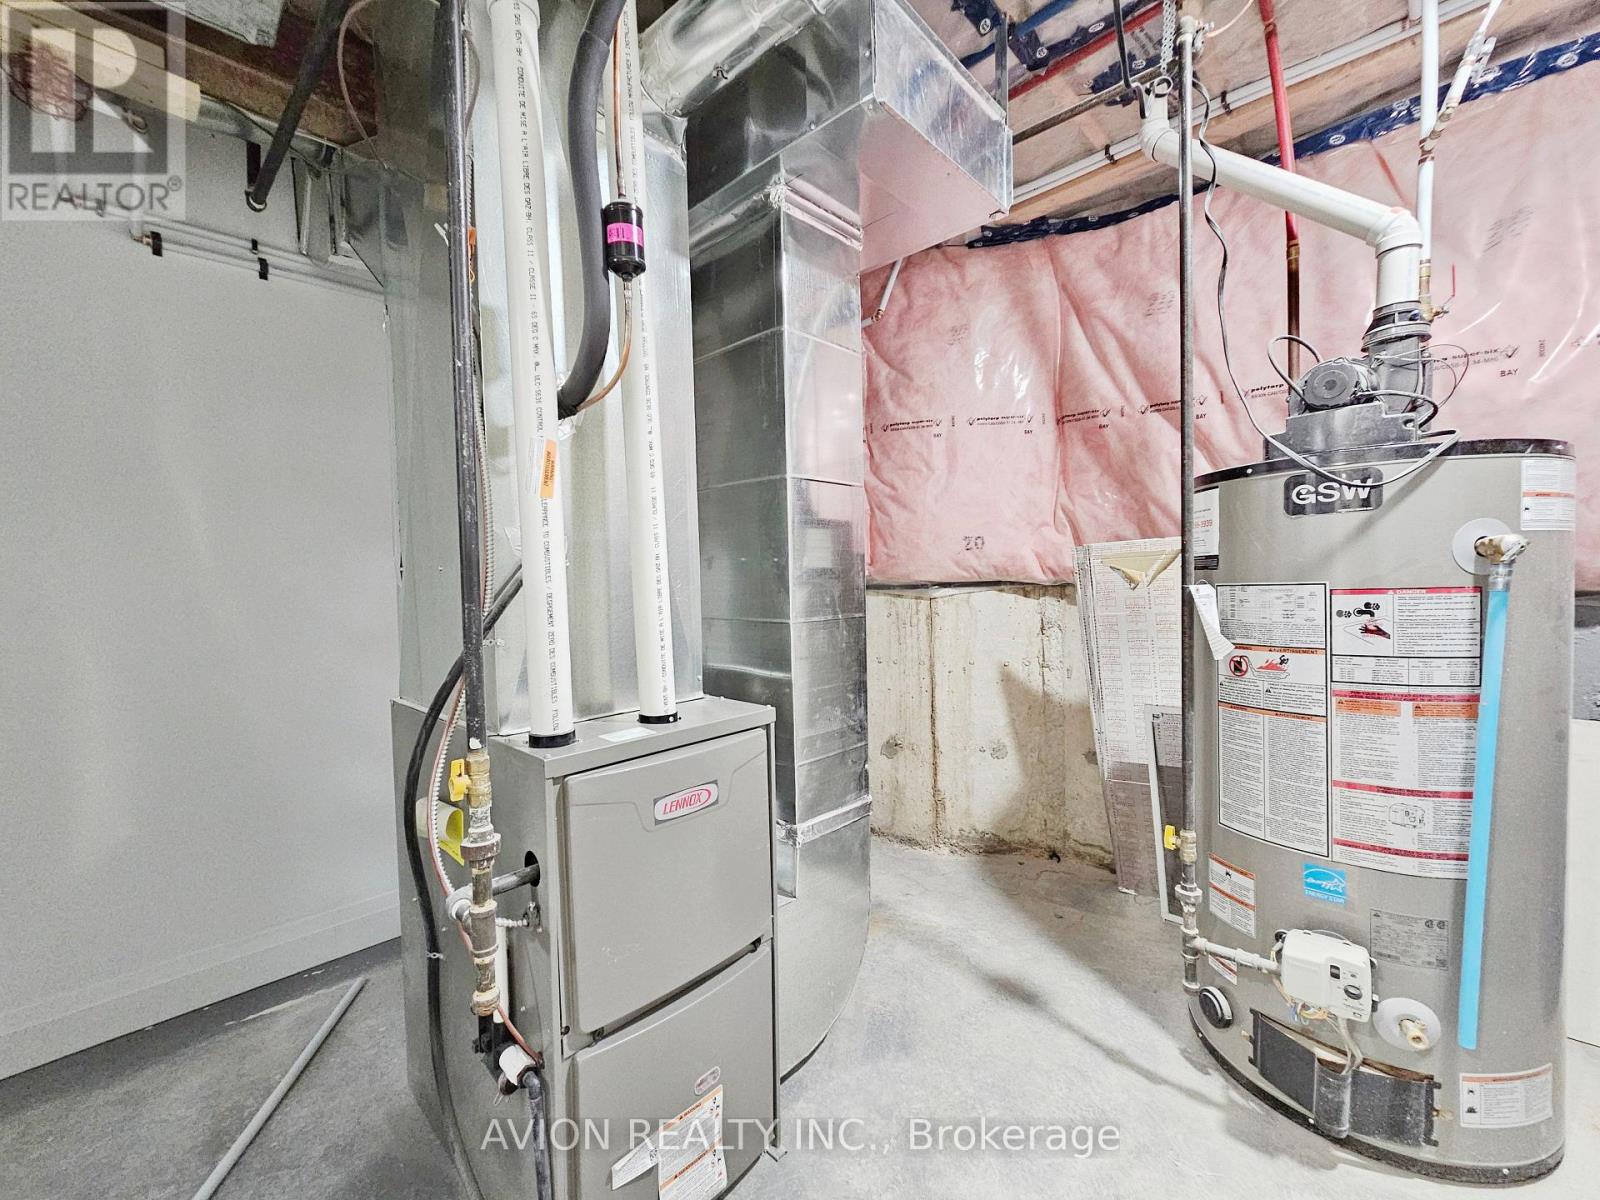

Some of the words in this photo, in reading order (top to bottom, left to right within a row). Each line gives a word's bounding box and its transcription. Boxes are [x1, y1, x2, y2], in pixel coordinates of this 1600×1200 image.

[517, 66, 526, 98] CONDUITE
[519, 100, 526, 109] DE
[522, 160, 531, 179] LIBRE
[528, 267, 536, 290] CLASSE
[1499, 368, 1519, 377] BAY
[1291, 478, 1373, 505] GSW
[662, 791, 703, 815] LENNOX
